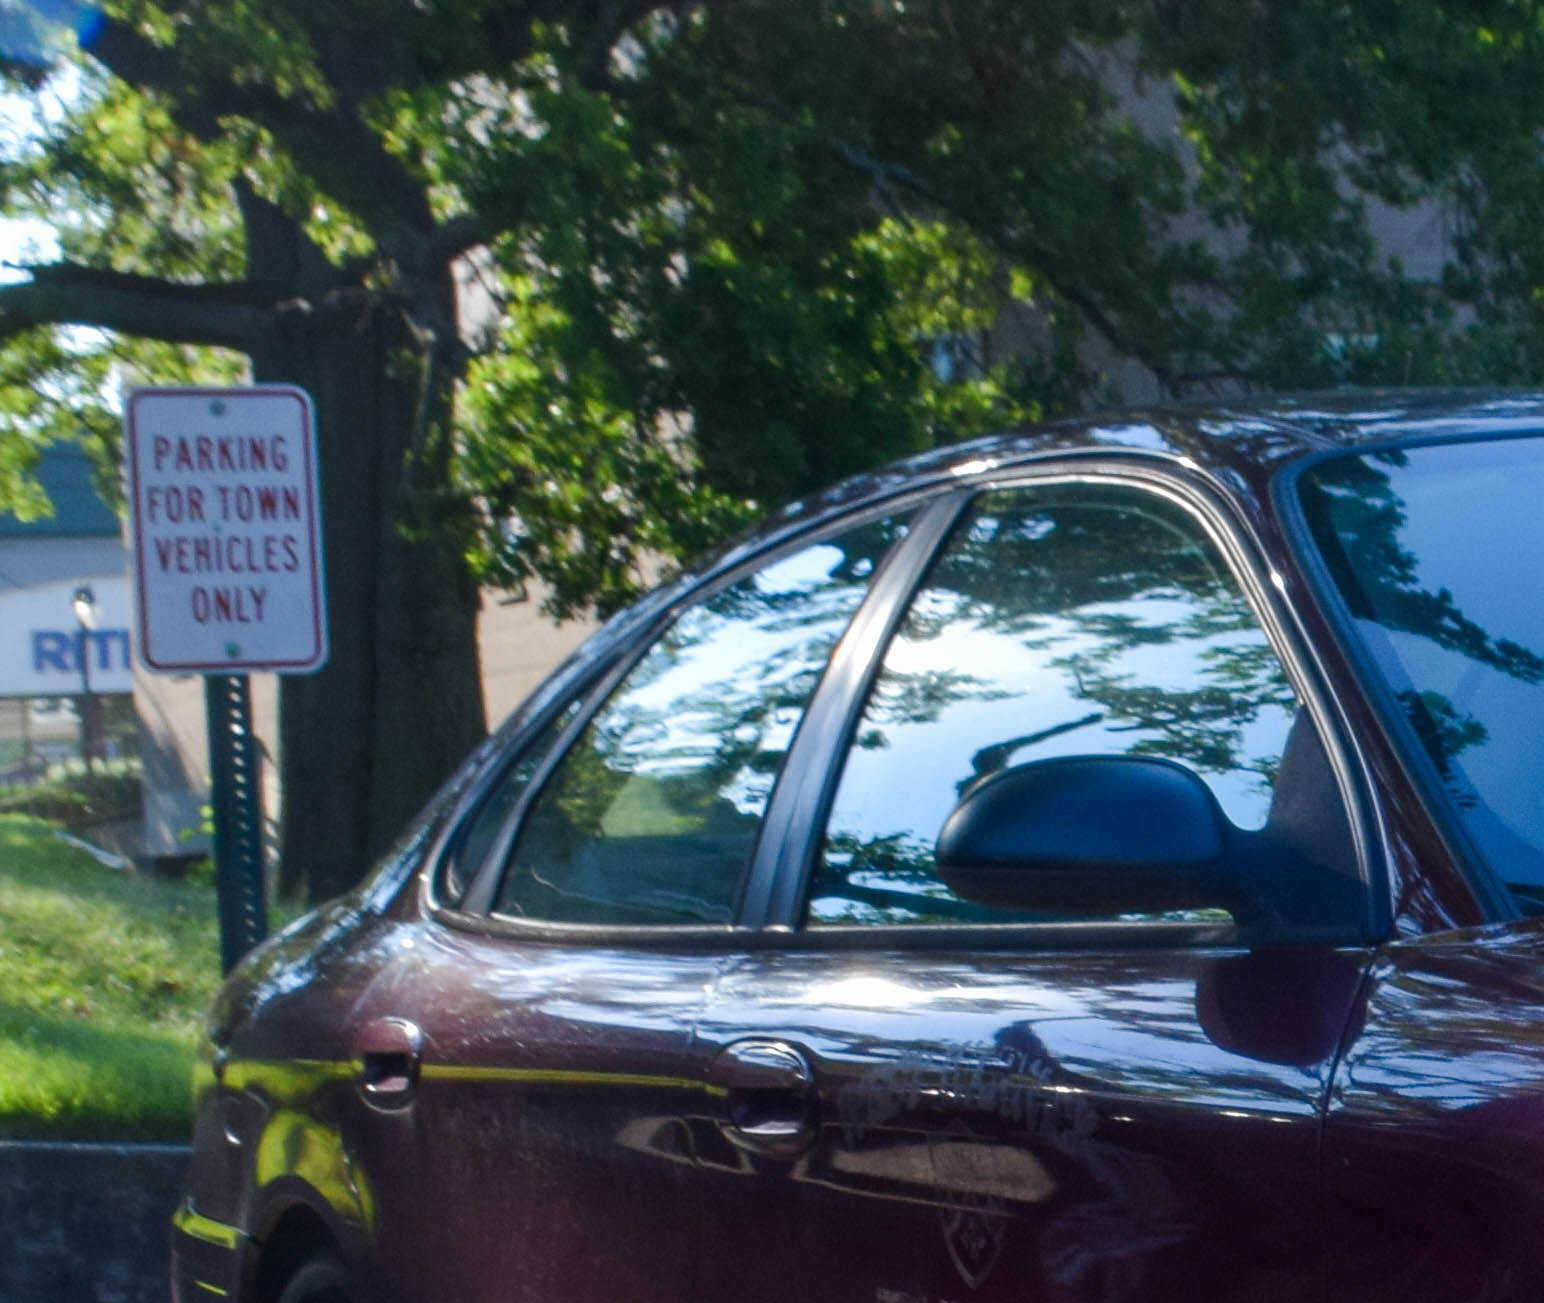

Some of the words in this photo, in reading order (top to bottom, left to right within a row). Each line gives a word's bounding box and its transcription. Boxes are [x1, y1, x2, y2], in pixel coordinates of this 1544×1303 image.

[154, 434, 288, 472] PARKING
[147, 485, 206, 523] FOR
[216, 485, 299, 522] TOWN
[154, 535, 299, 573] VEHICLES
[191, 585, 267, 625] ONLY
